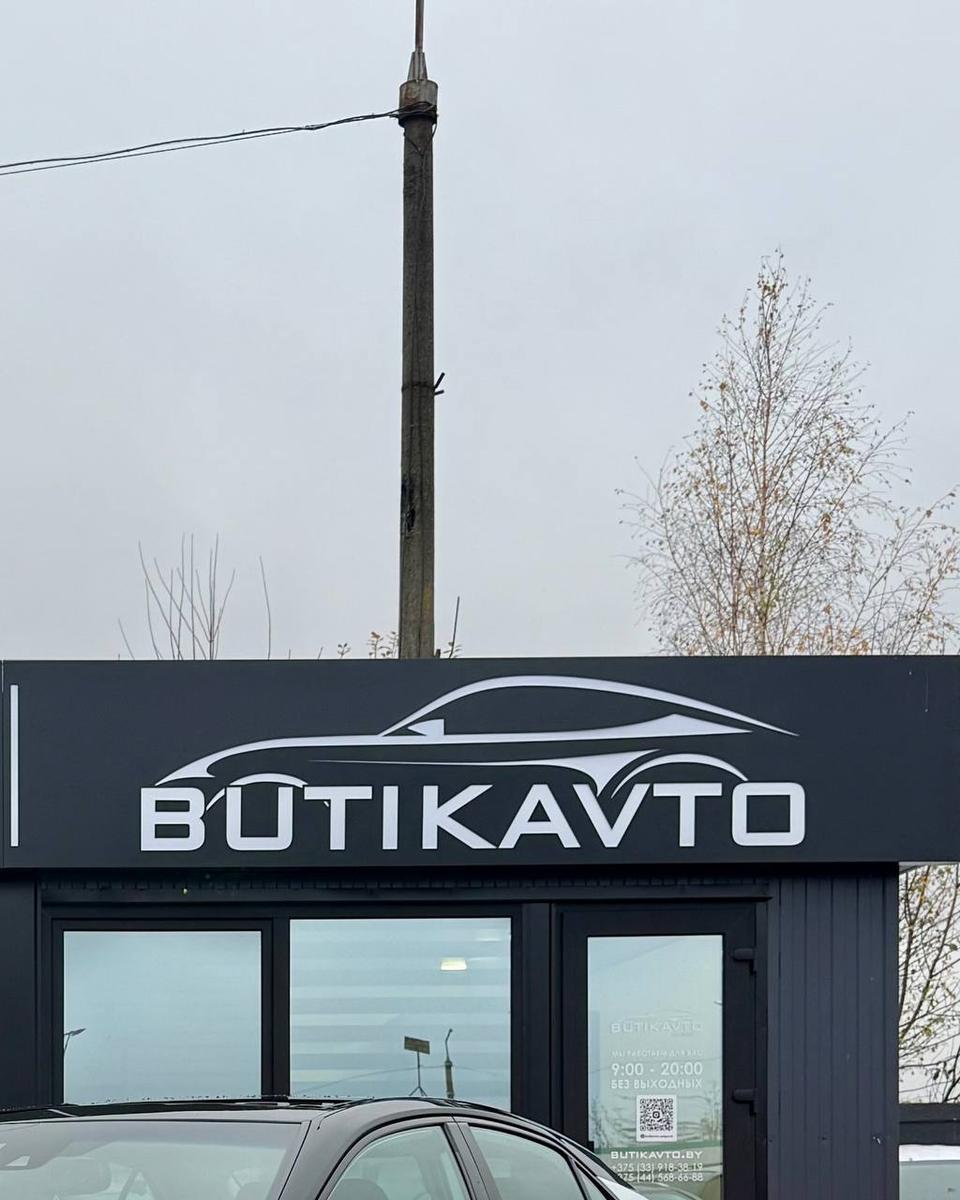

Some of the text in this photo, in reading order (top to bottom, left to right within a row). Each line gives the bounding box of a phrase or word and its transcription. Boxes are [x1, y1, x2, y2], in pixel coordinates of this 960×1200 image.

[140, 781, 806, 851] BUTIKAVTO
[611, 1063, 644, 1076] 9:00
[661, 1062, 703, 1075] 20:00
[611, 1079, 703, 1089] БЕЗ ВЫХОДНЫХ
[610, 1151, 703, 1159] BUTIKAVTO.BY
[637, 1163, 655, 1173] (33)
